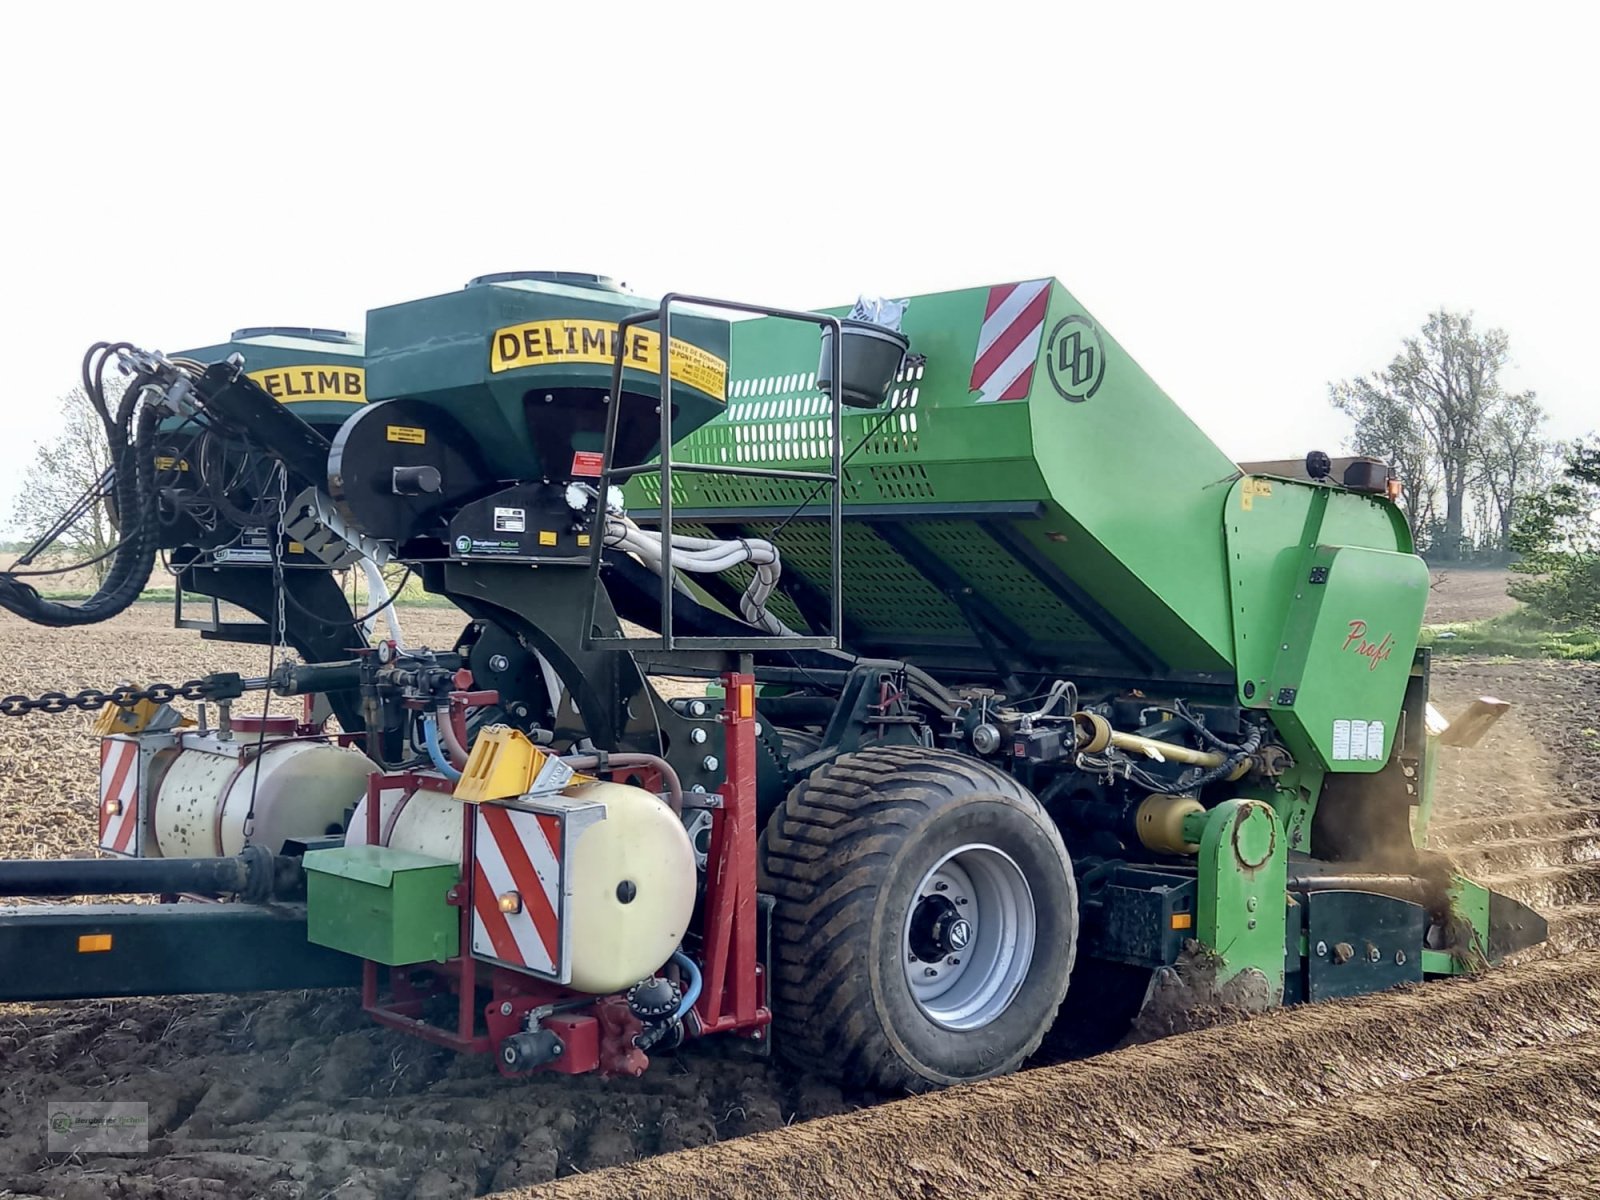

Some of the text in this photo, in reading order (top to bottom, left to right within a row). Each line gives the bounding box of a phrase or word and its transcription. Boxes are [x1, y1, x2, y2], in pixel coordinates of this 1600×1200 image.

[499, 327, 649, 363] DELIMBE
[255, 371, 362, 397] ELIMB
[1342, 619, 1396, 672] Profi
